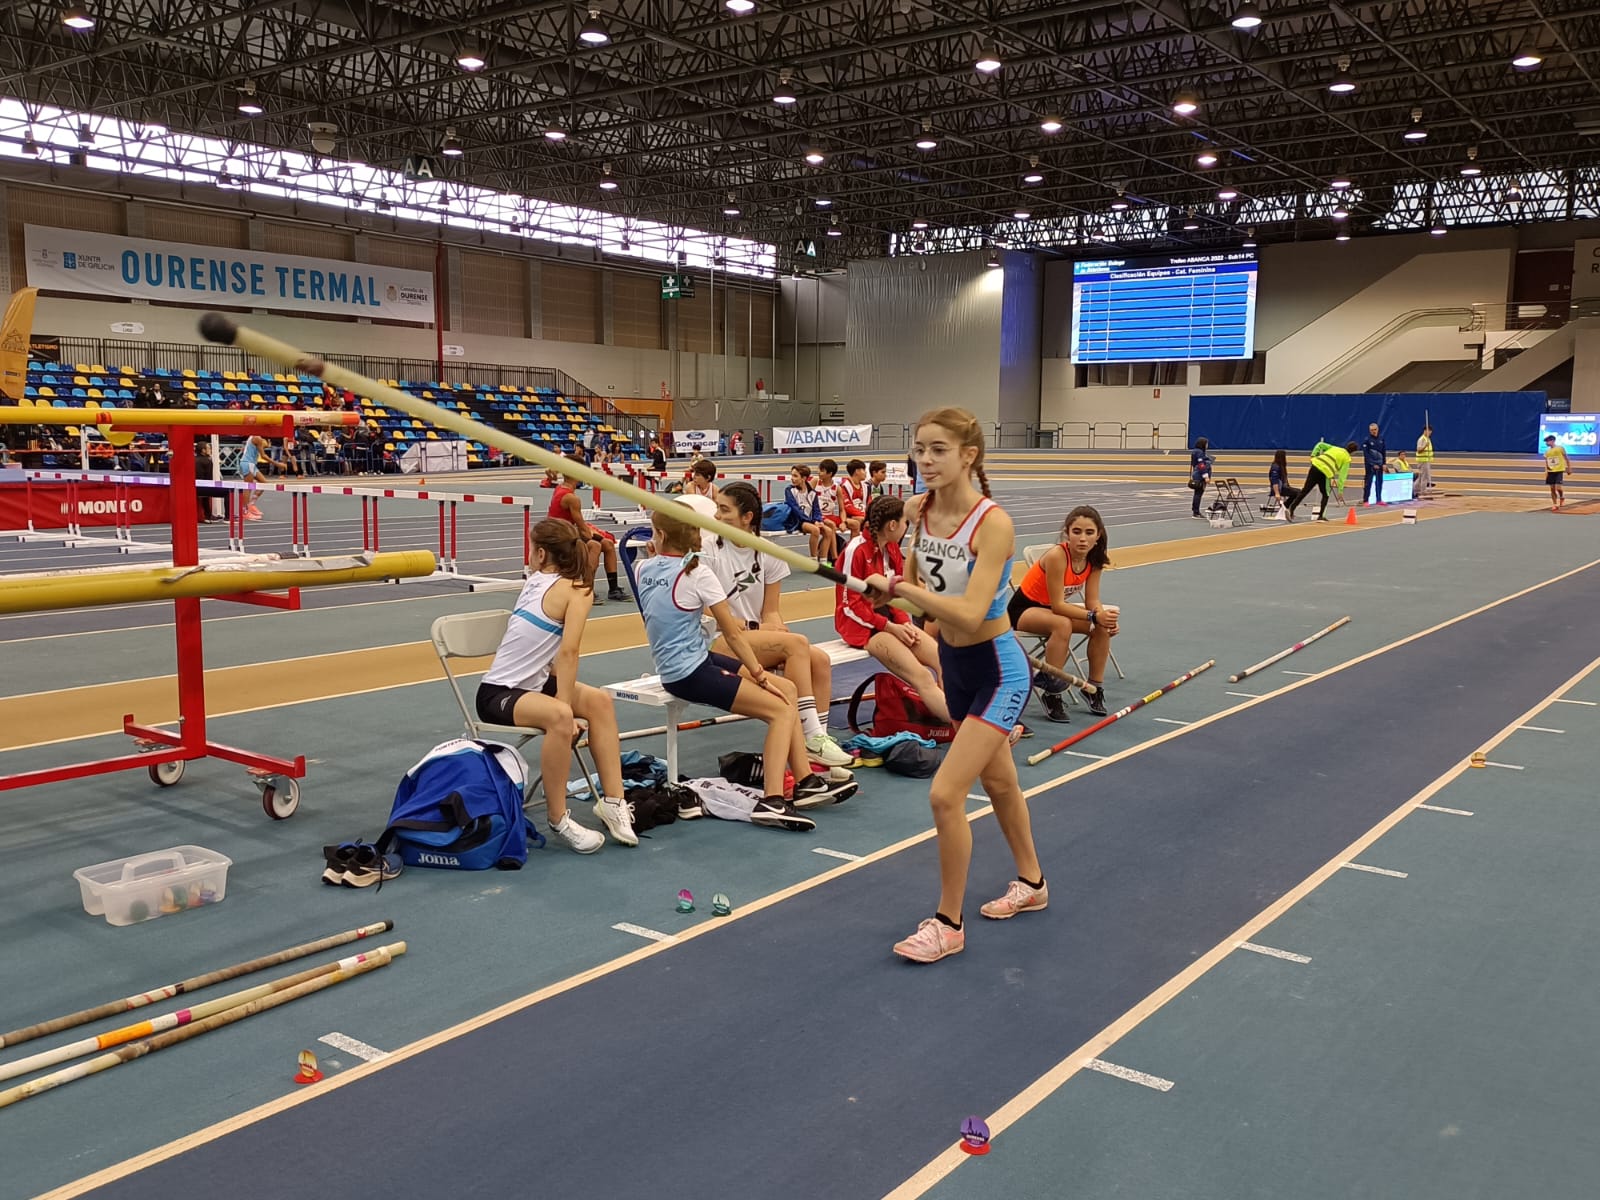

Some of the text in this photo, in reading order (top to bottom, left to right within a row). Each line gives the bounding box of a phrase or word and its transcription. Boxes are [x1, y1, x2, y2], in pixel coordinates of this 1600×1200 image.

[88, 263, 115, 271] GALICIA
[121, 250, 381, 306] OURENSE TERMAL
[400, 292, 428, 301] OURENSE
[822, 502, 829, 511] 2
[926, 556, 946, 592] 3
[616, 691, 639, 701] MONDO
